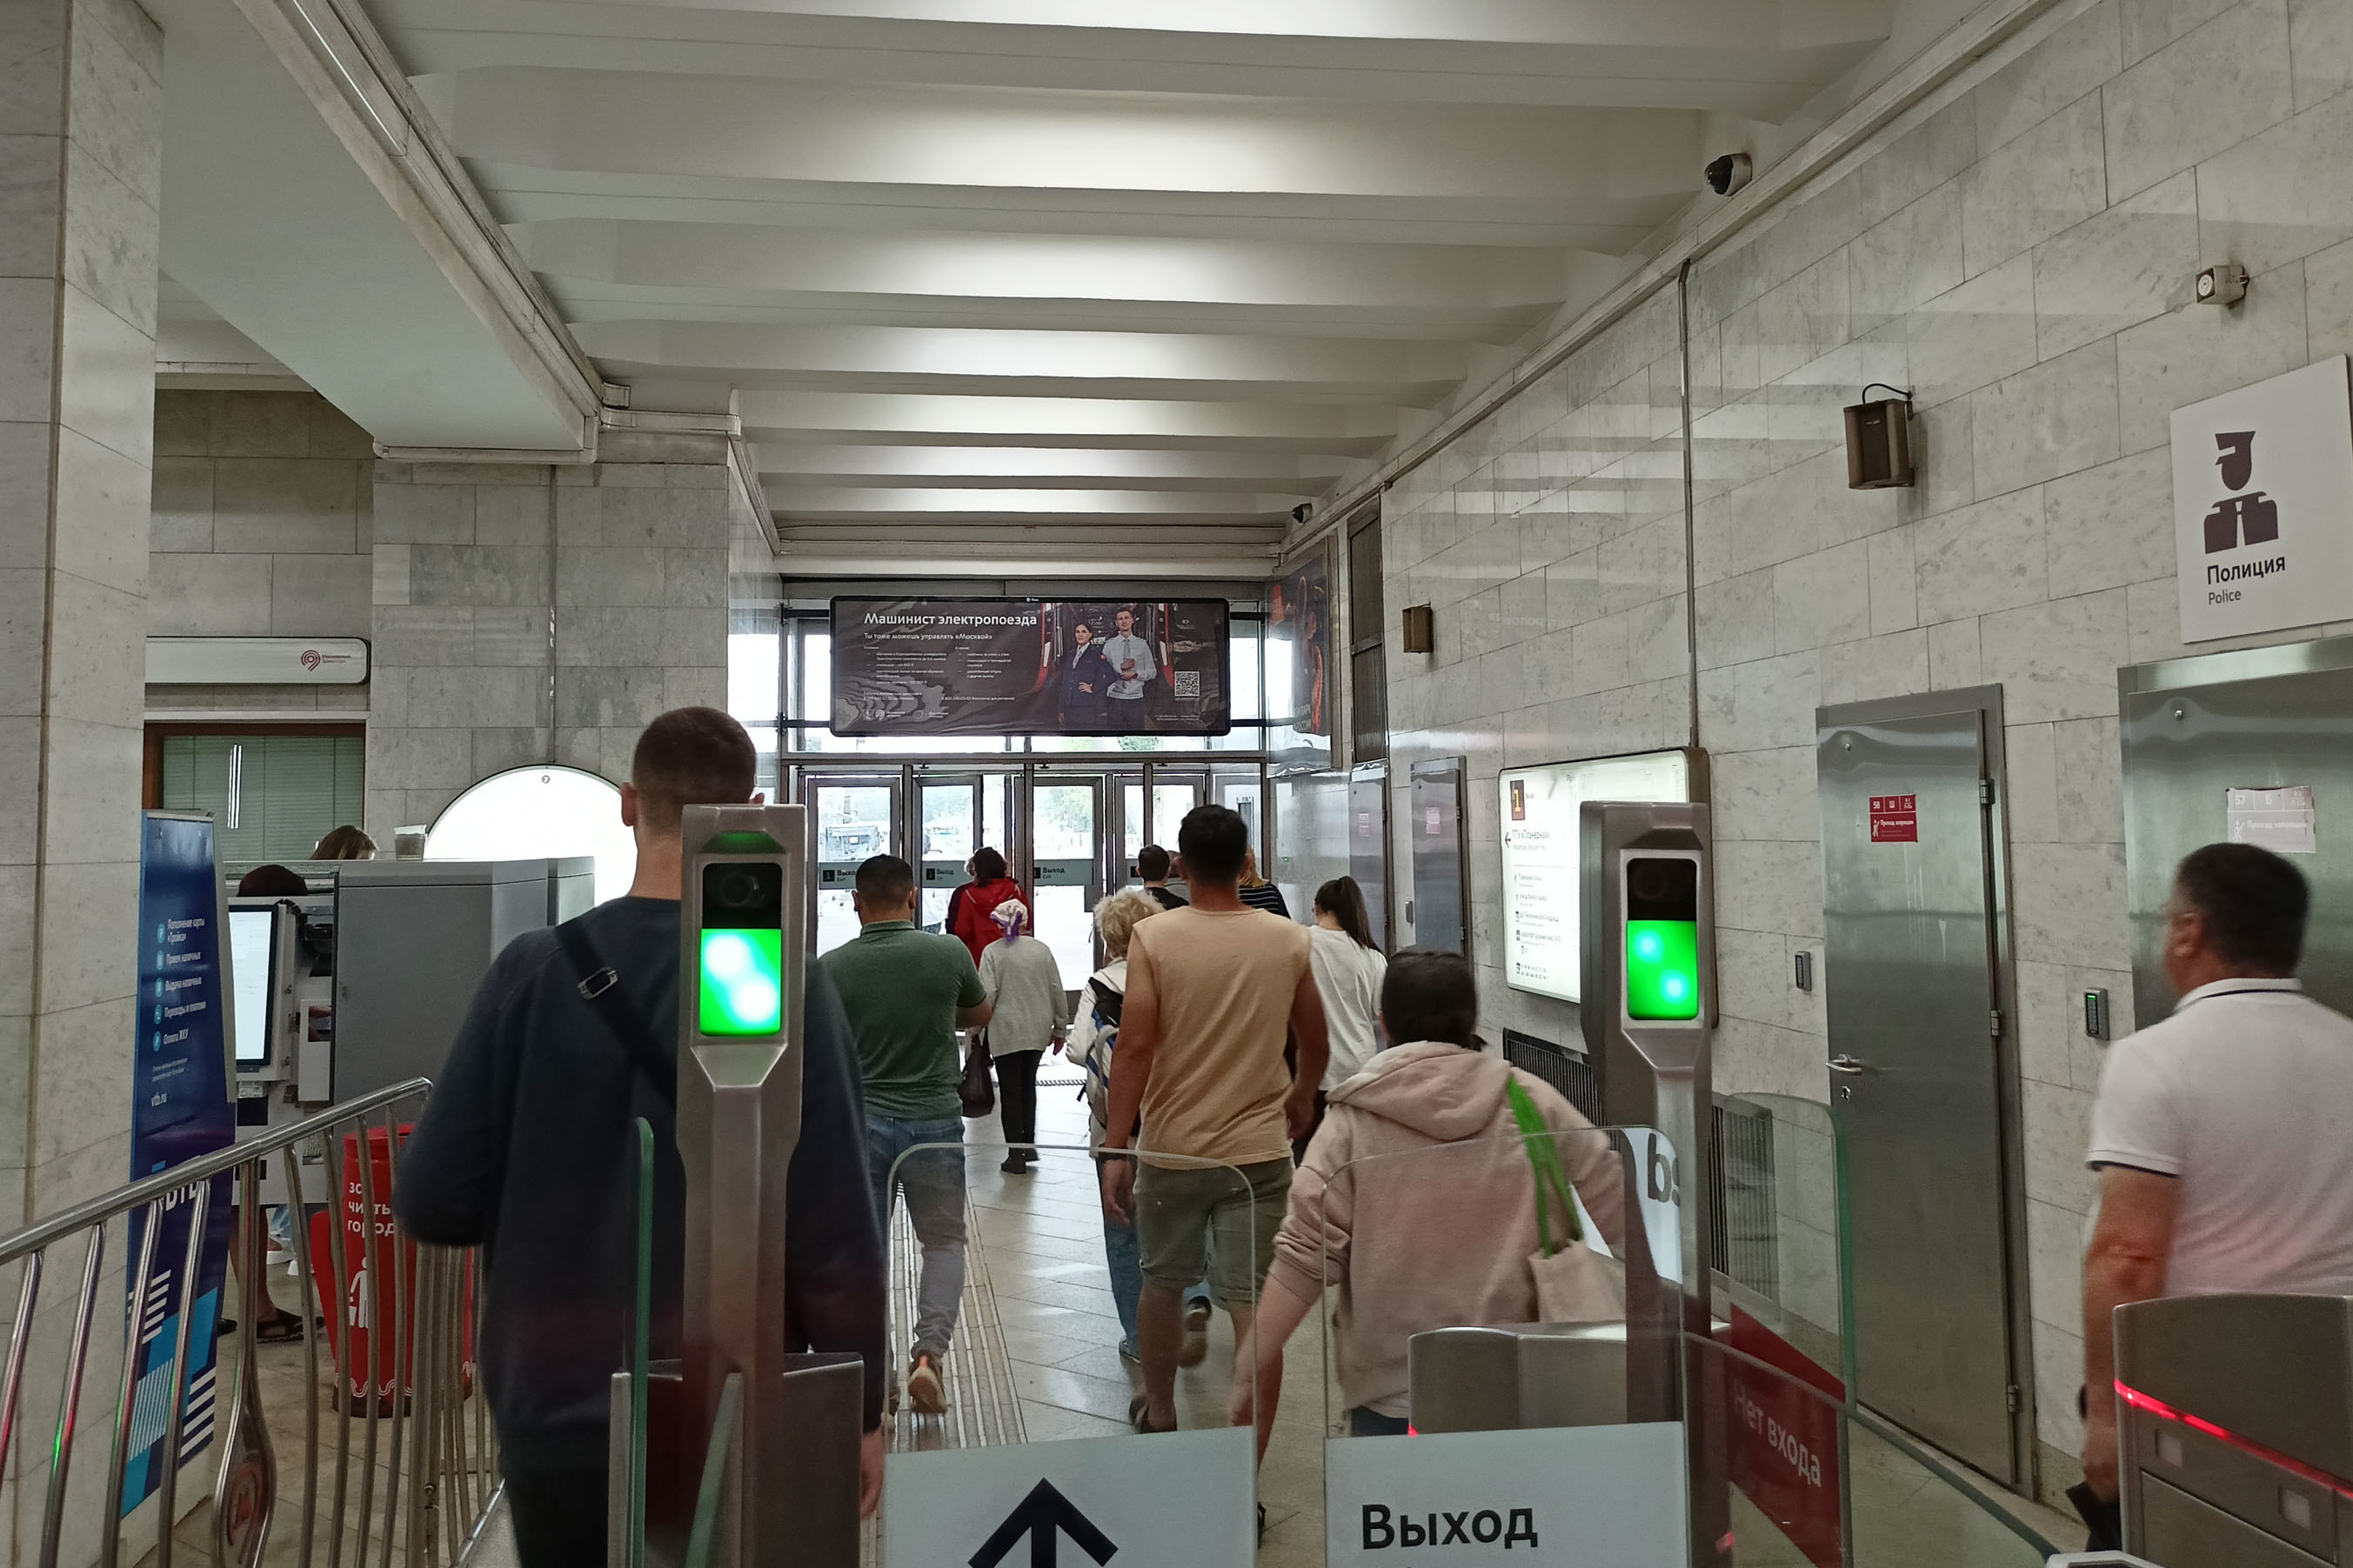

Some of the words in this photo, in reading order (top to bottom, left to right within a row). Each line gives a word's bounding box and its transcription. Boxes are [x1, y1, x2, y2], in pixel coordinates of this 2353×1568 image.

[2207, 556, 2286, 584] Полиция
[2209, 589, 2242, 605] Police
[864, 612, 936, 624] Машинист
[938, 615, 1037, 627] электропоезда
[1767, 1416, 1822, 1488] входа
[1362, 1504, 1539, 1550] Выход
